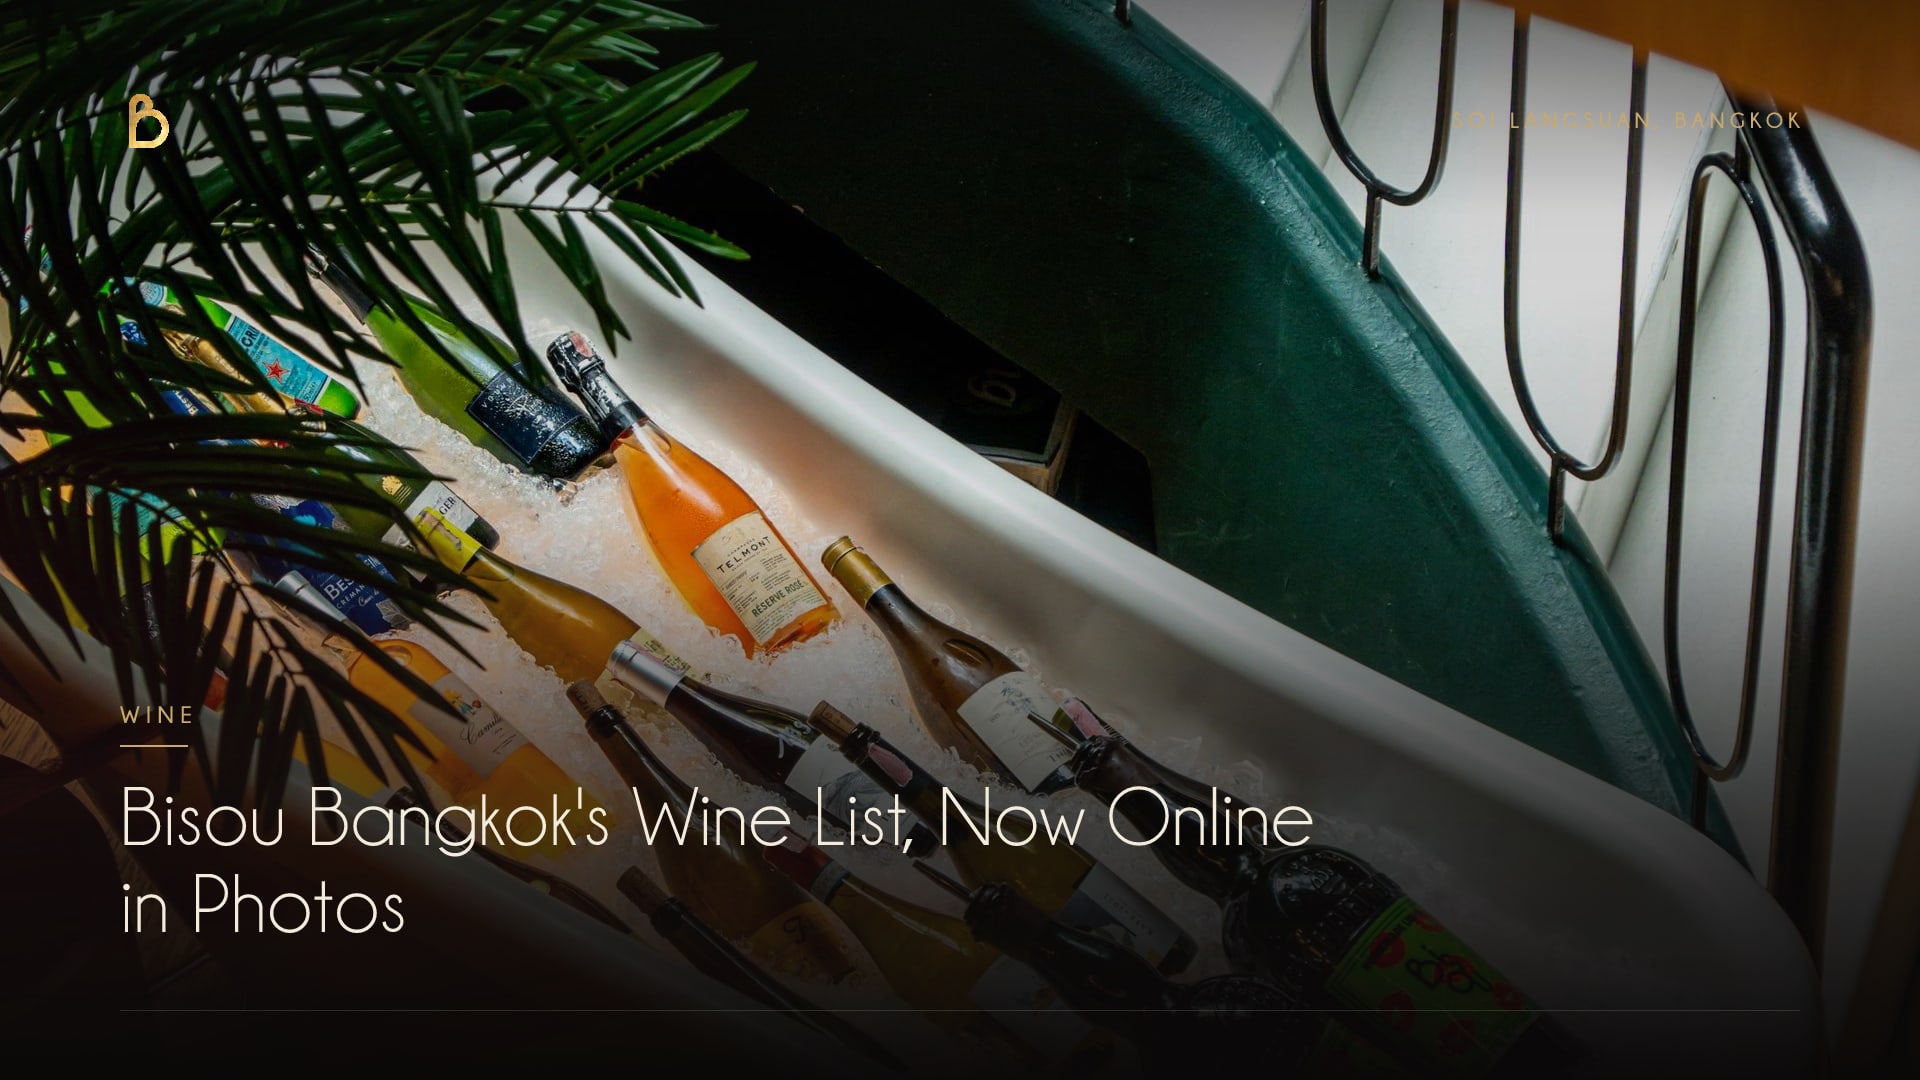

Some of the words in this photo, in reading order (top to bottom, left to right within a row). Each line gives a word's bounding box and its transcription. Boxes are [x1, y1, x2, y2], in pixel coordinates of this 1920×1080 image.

[717, 537, 771, 574] TELMONT
[752, 589, 786, 617] RÉSERVE
[785, 578, 804, 594] ROSÉ
